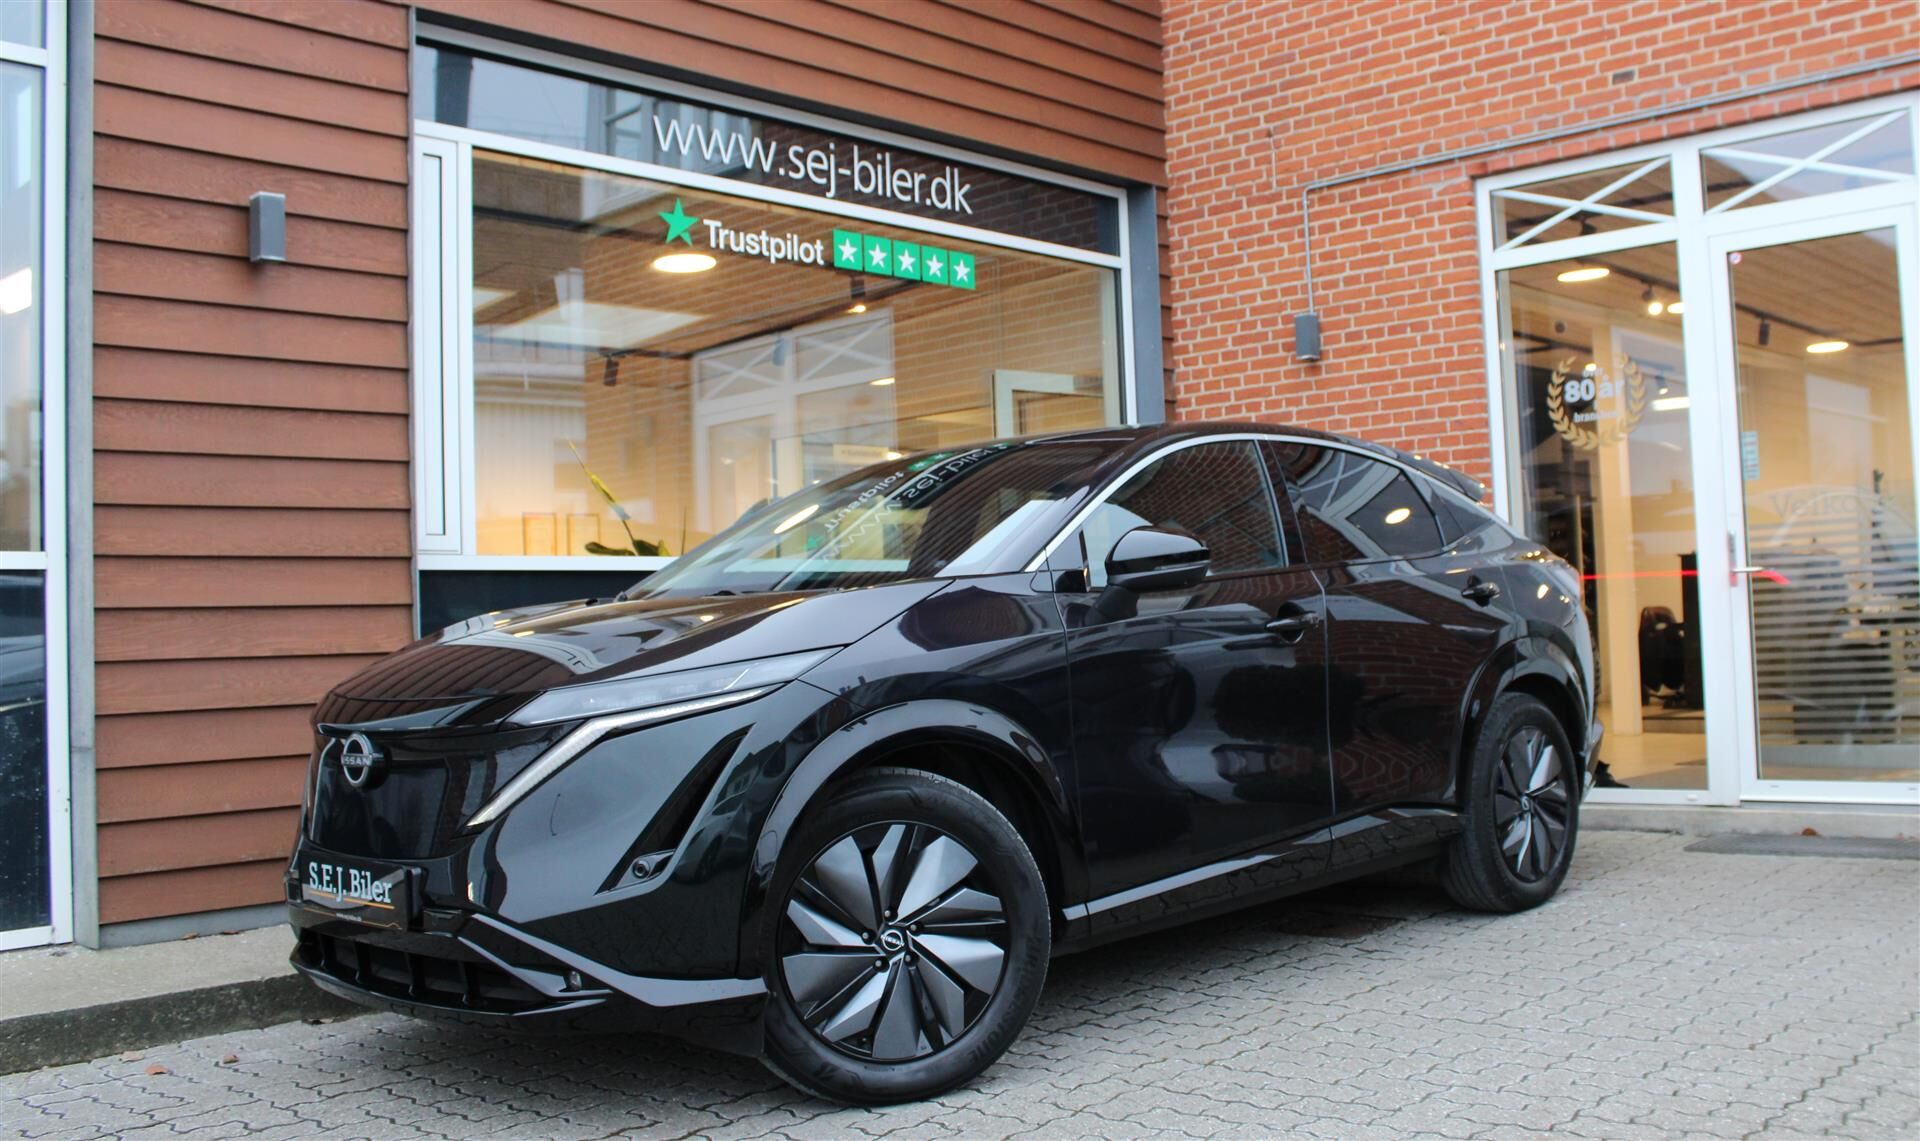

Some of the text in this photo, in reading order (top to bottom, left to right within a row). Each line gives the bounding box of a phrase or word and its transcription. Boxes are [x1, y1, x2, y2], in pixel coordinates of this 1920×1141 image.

[653, 114, 972, 214] www.sej-biler.dk
[703, 219, 825, 266] Trustpilot
[1564, 379, 1595, 403] 80
[341, 755, 370, 766] ISSAN
[309, 861, 392, 903] S.E.J. Biler
